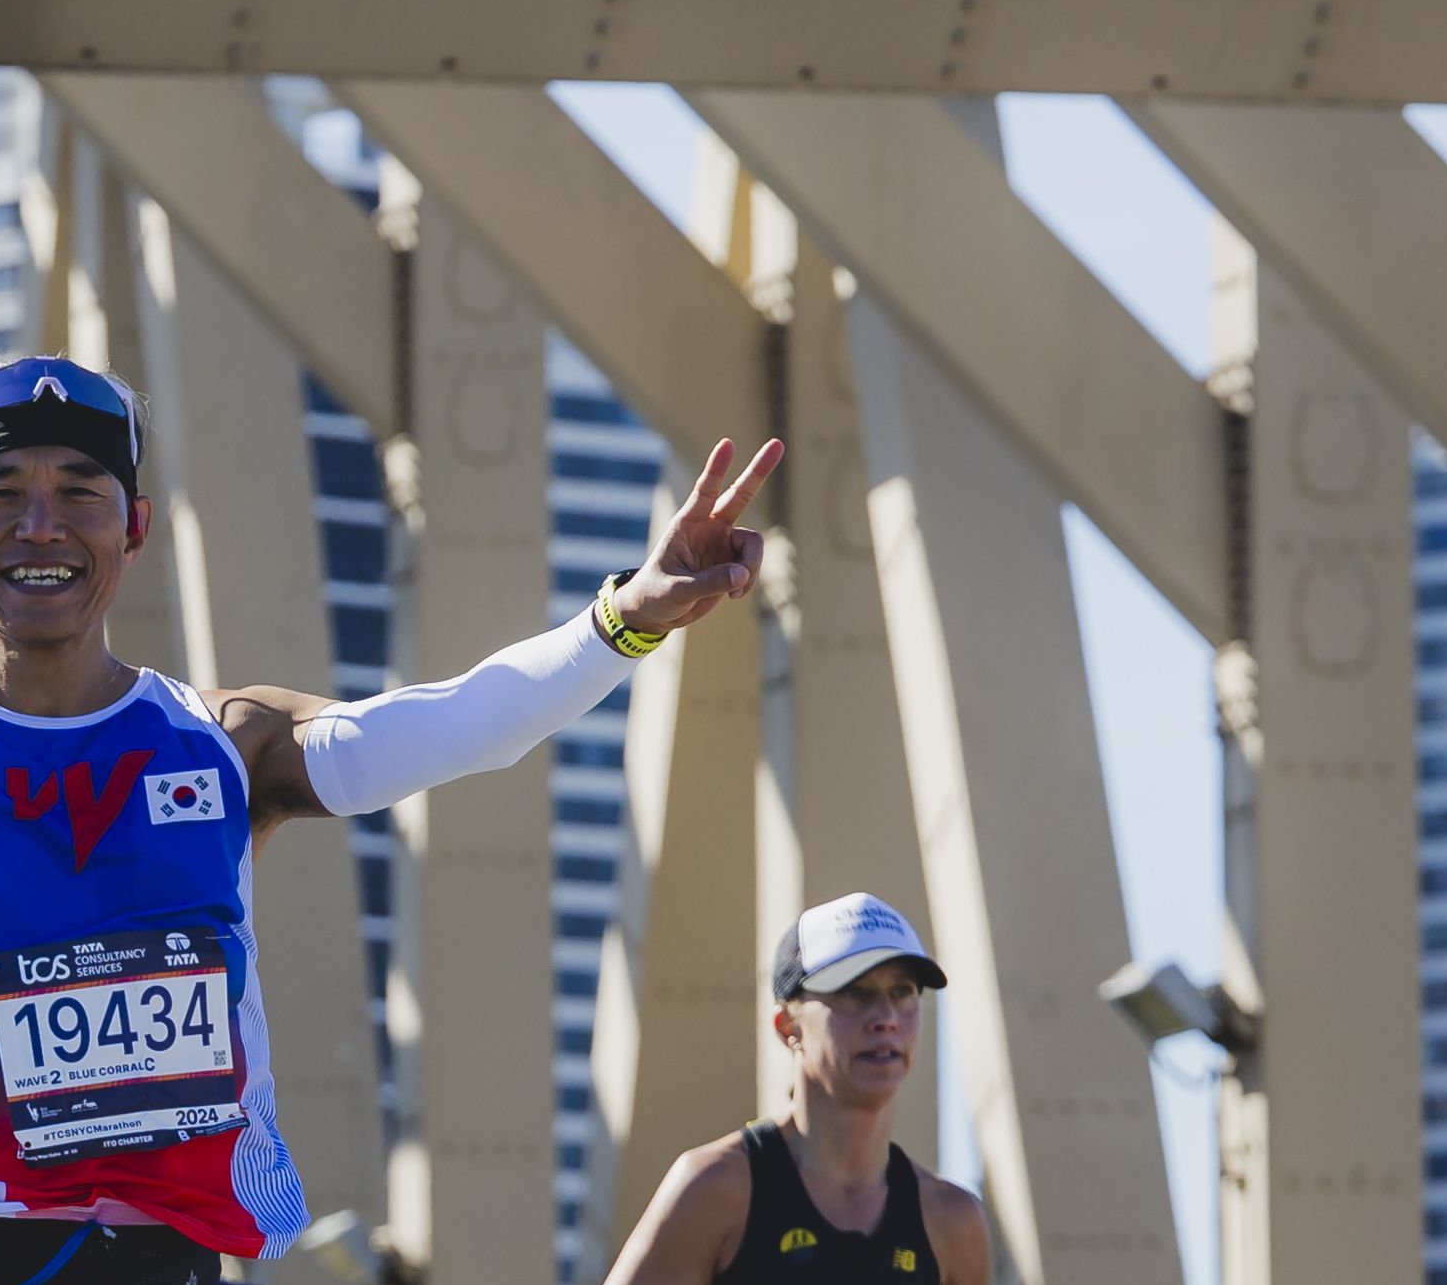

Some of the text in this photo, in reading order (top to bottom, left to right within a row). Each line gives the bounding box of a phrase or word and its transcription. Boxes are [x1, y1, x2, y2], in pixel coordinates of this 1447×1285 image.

[72, 942, 105, 954] TATA
[74, 948, 146, 966] CONSULTANCY
[164, 953, 200, 966] TATA
[17, 954, 70, 985] tcs
[76, 963, 123, 977] SERVICES
[13, 981, 215, 1068] 19434
[14, 1057, 156, 1089] WAVE 2 BLUE CORRAL C
[175, 1108, 219, 1126] 2024
[43, 1119, 143, 1142] #TCSNYCMarathon
[177, 1129, 190, 1144] B
[117, 1134, 154, 1147] CHARTER
